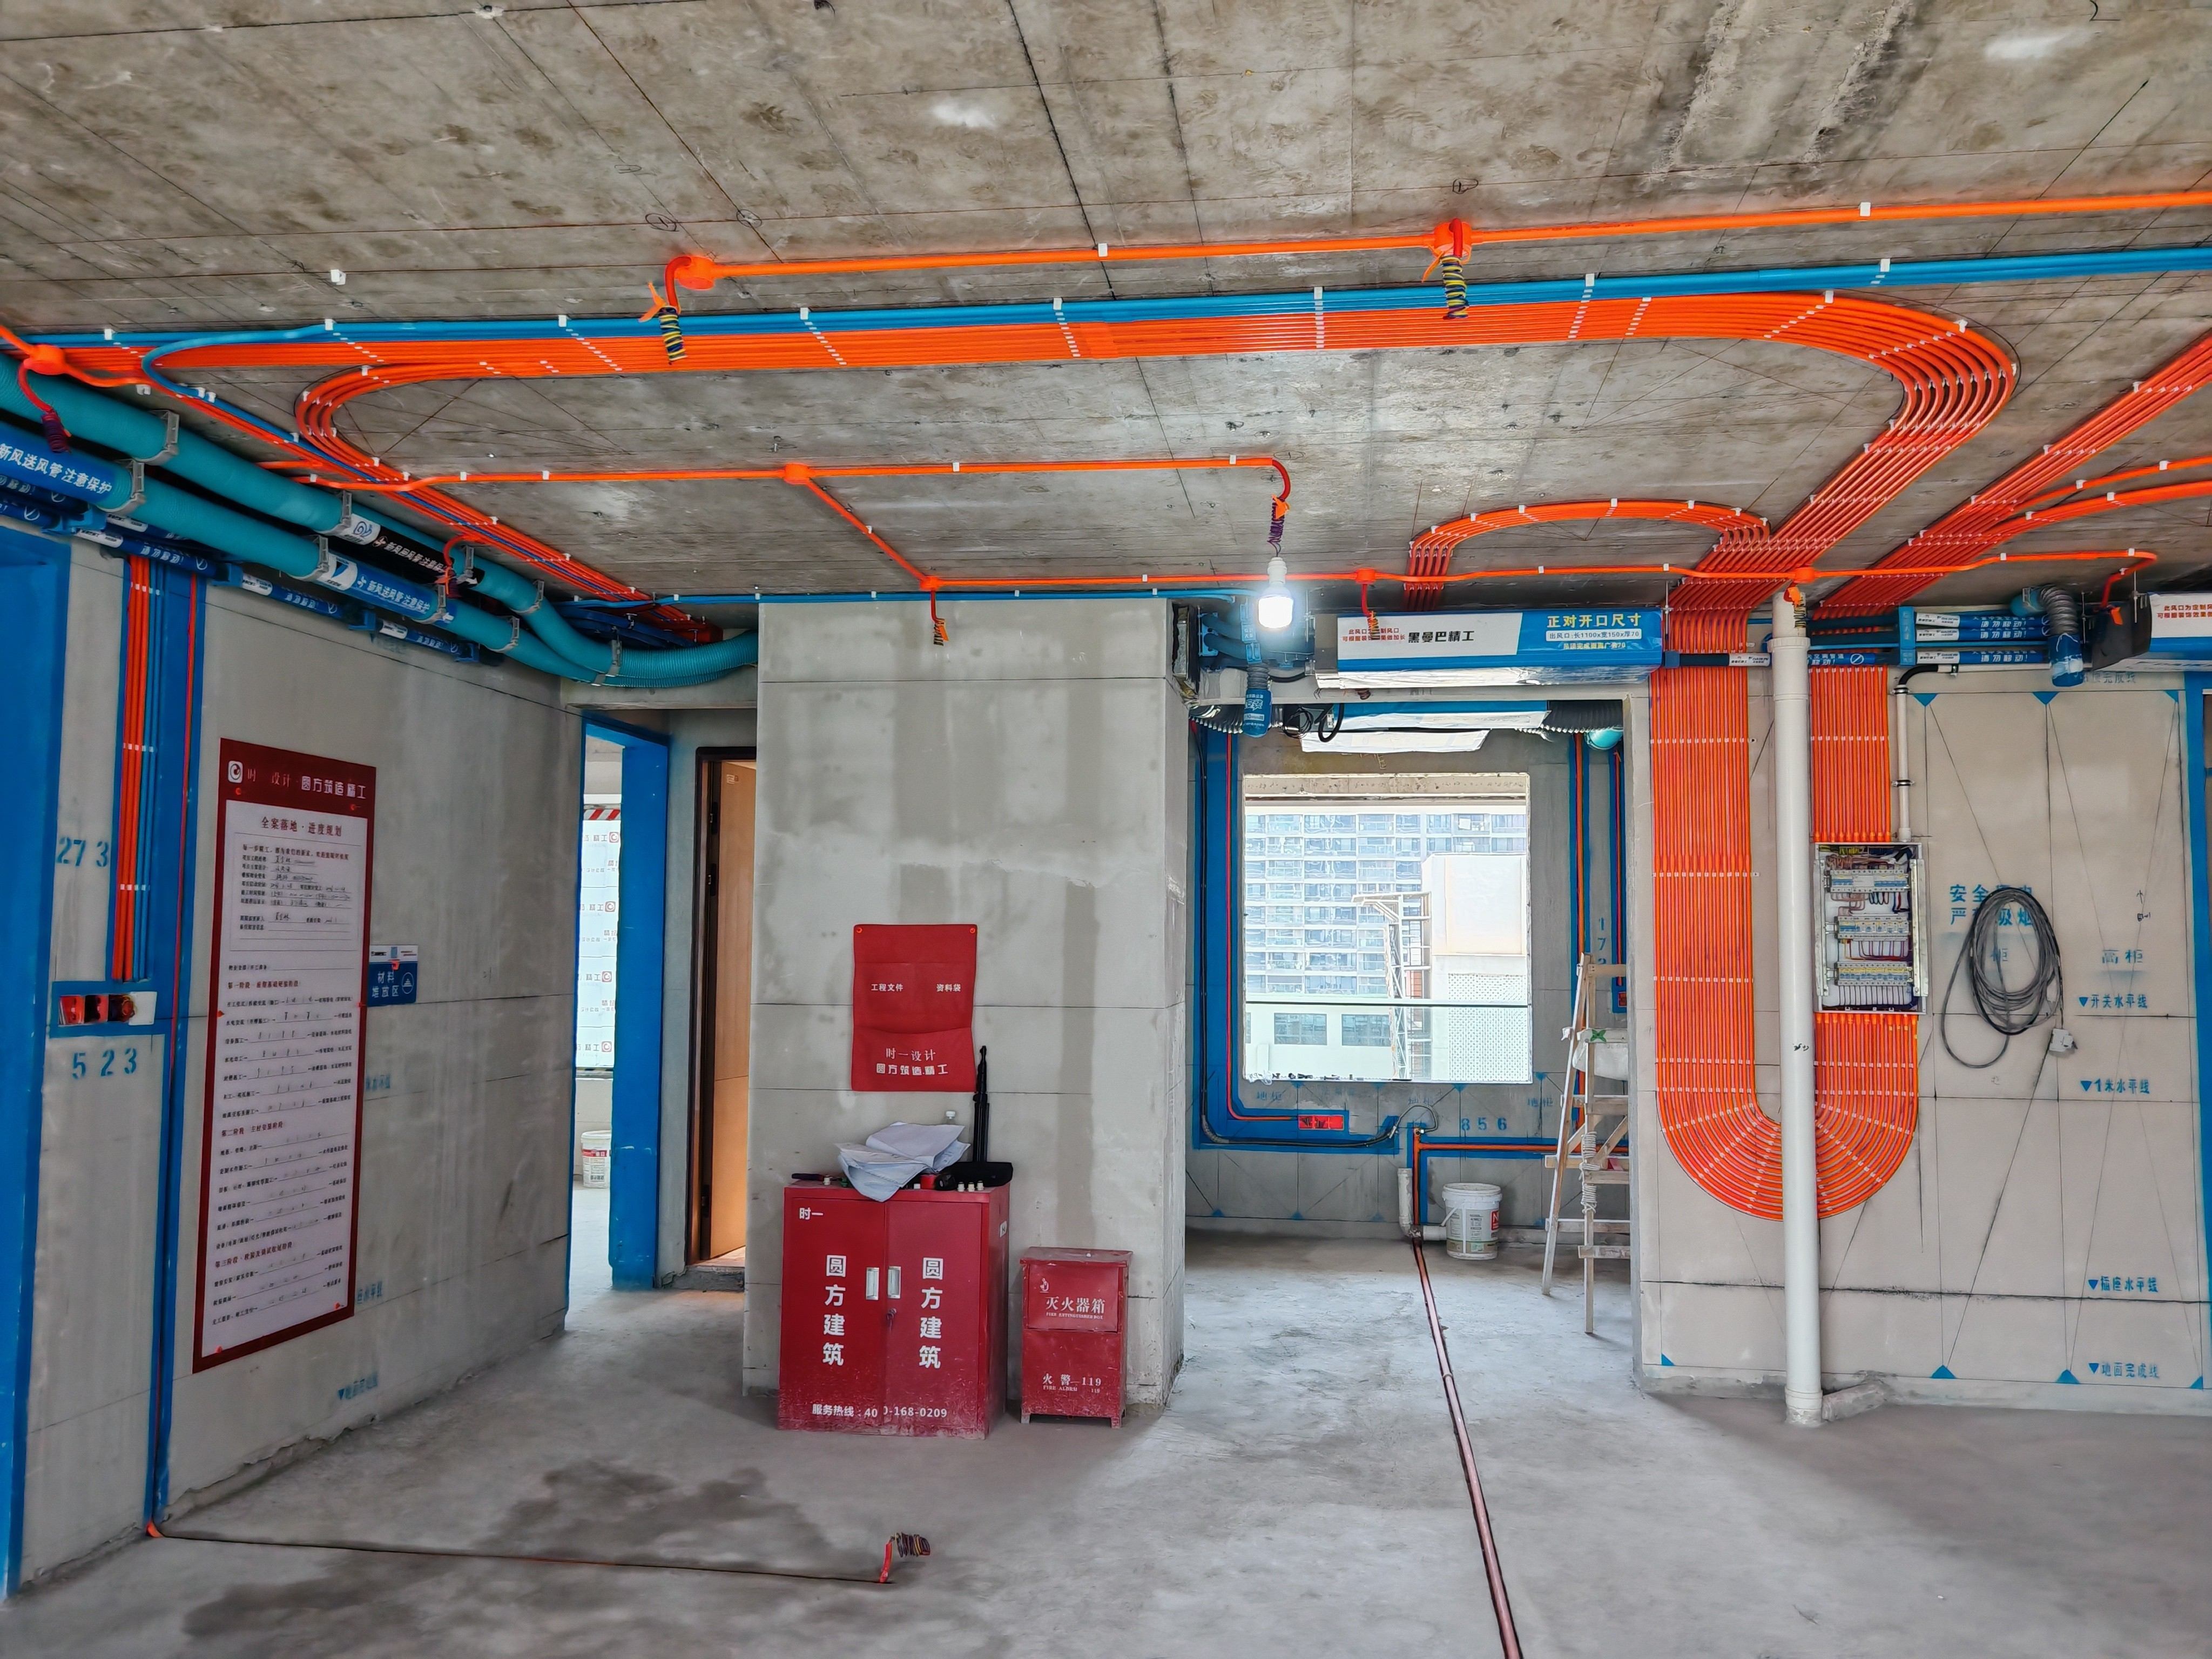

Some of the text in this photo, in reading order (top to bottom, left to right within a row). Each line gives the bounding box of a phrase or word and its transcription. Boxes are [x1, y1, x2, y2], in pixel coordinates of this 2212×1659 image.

[385, 542, 448, 572] 新风回风管注意保
[1547, 612, 1641, 628] 正对开口尺寸
[1408, 630, 1475, 643] 黑曼巴精工
[377, 970, 395, 984] 材料
[372, 985, 400, 998] 堆放区
[871, 983, 962, 992] 工程文件 资料袋
[2091, 994, 2148, 1008] 开关水平线
[886, 1048, 936, 1061] 时一设计
[876, 1063, 948, 1076] 圆方筑造精工
[2094, 1078, 2150, 1095] 1米水平线
[799, 1208, 824, 1220] 时一
[2100, 1275, 2159, 1293] 插座水平线
[822, 1255, 847, 1366] 圆方建筑
[1046, 1296, 1106, 1314] 灭火器箱
[919, 1257, 943, 1369] 圆方建筑
[2101, 1362, 2160, 1379] 地面完成线
[1082, 1377, 1102, 1387] 119
